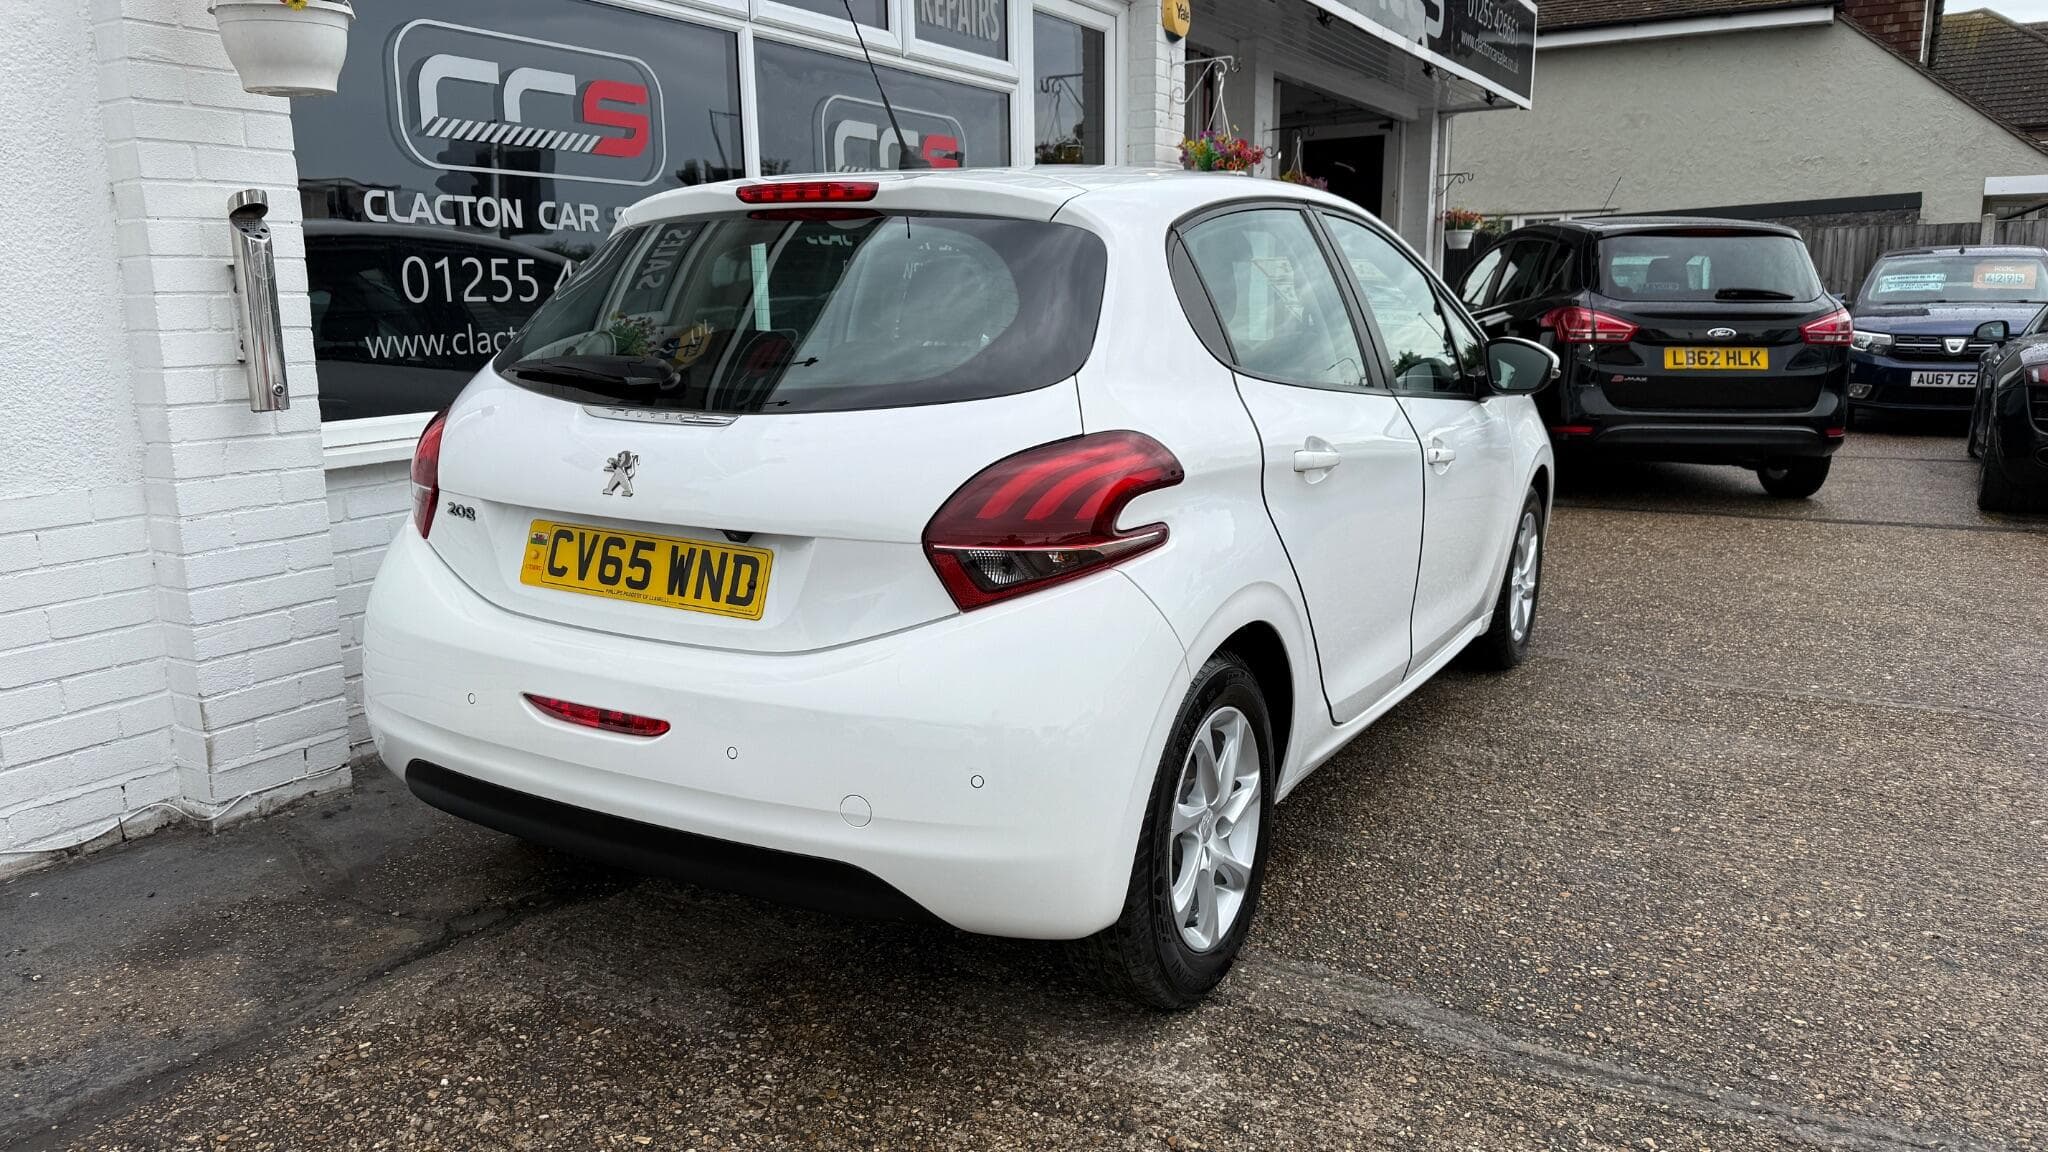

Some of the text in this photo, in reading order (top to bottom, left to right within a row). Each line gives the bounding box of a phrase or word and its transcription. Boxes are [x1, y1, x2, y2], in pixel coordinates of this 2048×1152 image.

[920, 0, 1000, 42] REPAIRS
[1175, 1, 1190, 23] Yale
[1467, 0, 1493, 29] 01255
[1494, 8, 1519, 47] 426661
[363, 189, 524, 229] CLACTON
[538, 201, 600, 232] CAR
[401, 256, 540, 304] 01255
[1673, 350, 1761, 366] LB62 HLK
[1916, 374, 1953, 386] AU67
[447, 501, 476, 521] 208
[547, 529, 760, 606] CV65 WND
